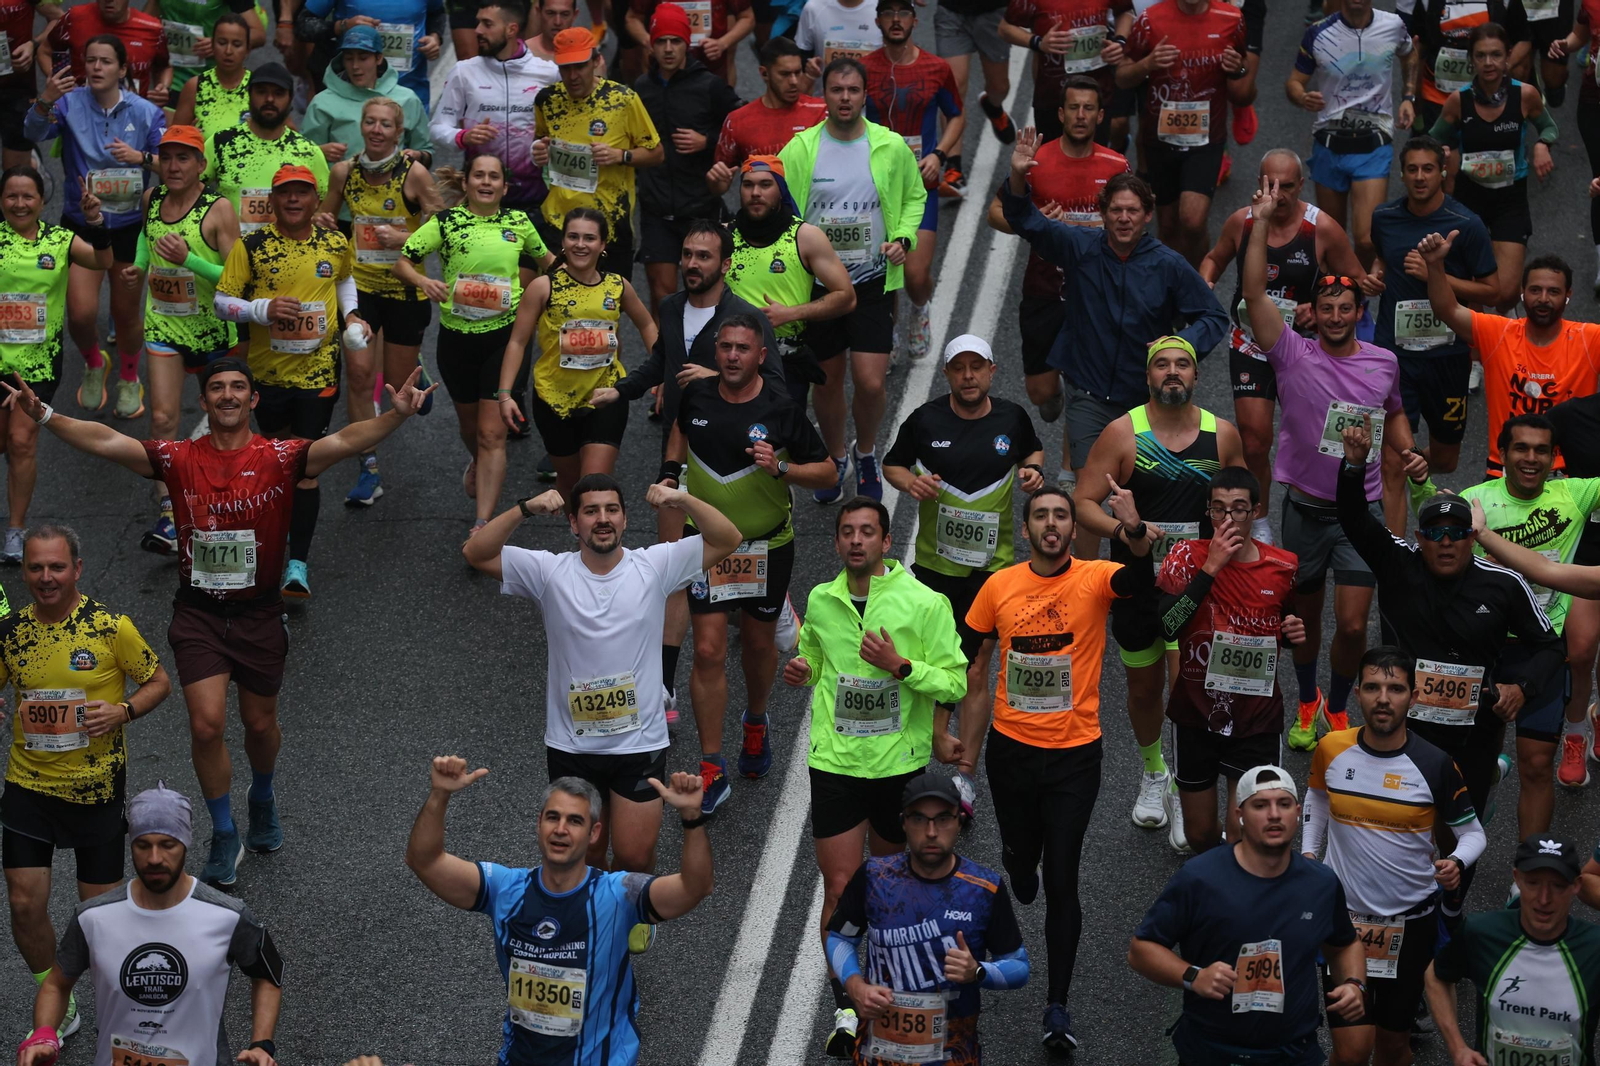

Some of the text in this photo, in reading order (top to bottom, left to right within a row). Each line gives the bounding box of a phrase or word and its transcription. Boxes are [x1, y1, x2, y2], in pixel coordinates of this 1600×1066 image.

[1443, 59, 1474, 75] 9276
[1166, 113, 1198, 128] 5632
[555, 151, 587, 170] 7746
[95, 180, 129, 195] 9917
[826, 227, 860, 242] 6956
[152, 278, 181, 295] 5221
[462, 283, 499, 302] 5604
[277, 315, 314, 332] 5876
[208, 483, 286, 515] MARATÓN
[945, 520, 984, 542] 6596
[200, 545, 238, 564] 7171
[715, 558, 752, 577] 5032
[1220, 647, 1263, 670] 8506
[1014, 667, 1055, 688] 7292
[1422, 676, 1467, 700] 5496
[574, 689, 629, 713] 13249
[844, 690, 886, 712] 8964
[28, 705, 69, 725] 5907
[1538, 848, 1562, 857] adidas
[944, 909, 972, 923] HOKA
[882, 918, 942, 947] MARATÓN
[1245, 957, 1281, 981] 5096
[125, 974, 182, 989] LENTISCO
[143, 985, 164, 994] TRAIL
[515, 976, 571, 1006] 11350
[1498, 999, 1572, 1024] Trent Park
[880, 1009, 926, 1034] 5158
[1498, 1048, 1559, 1066] 10281
